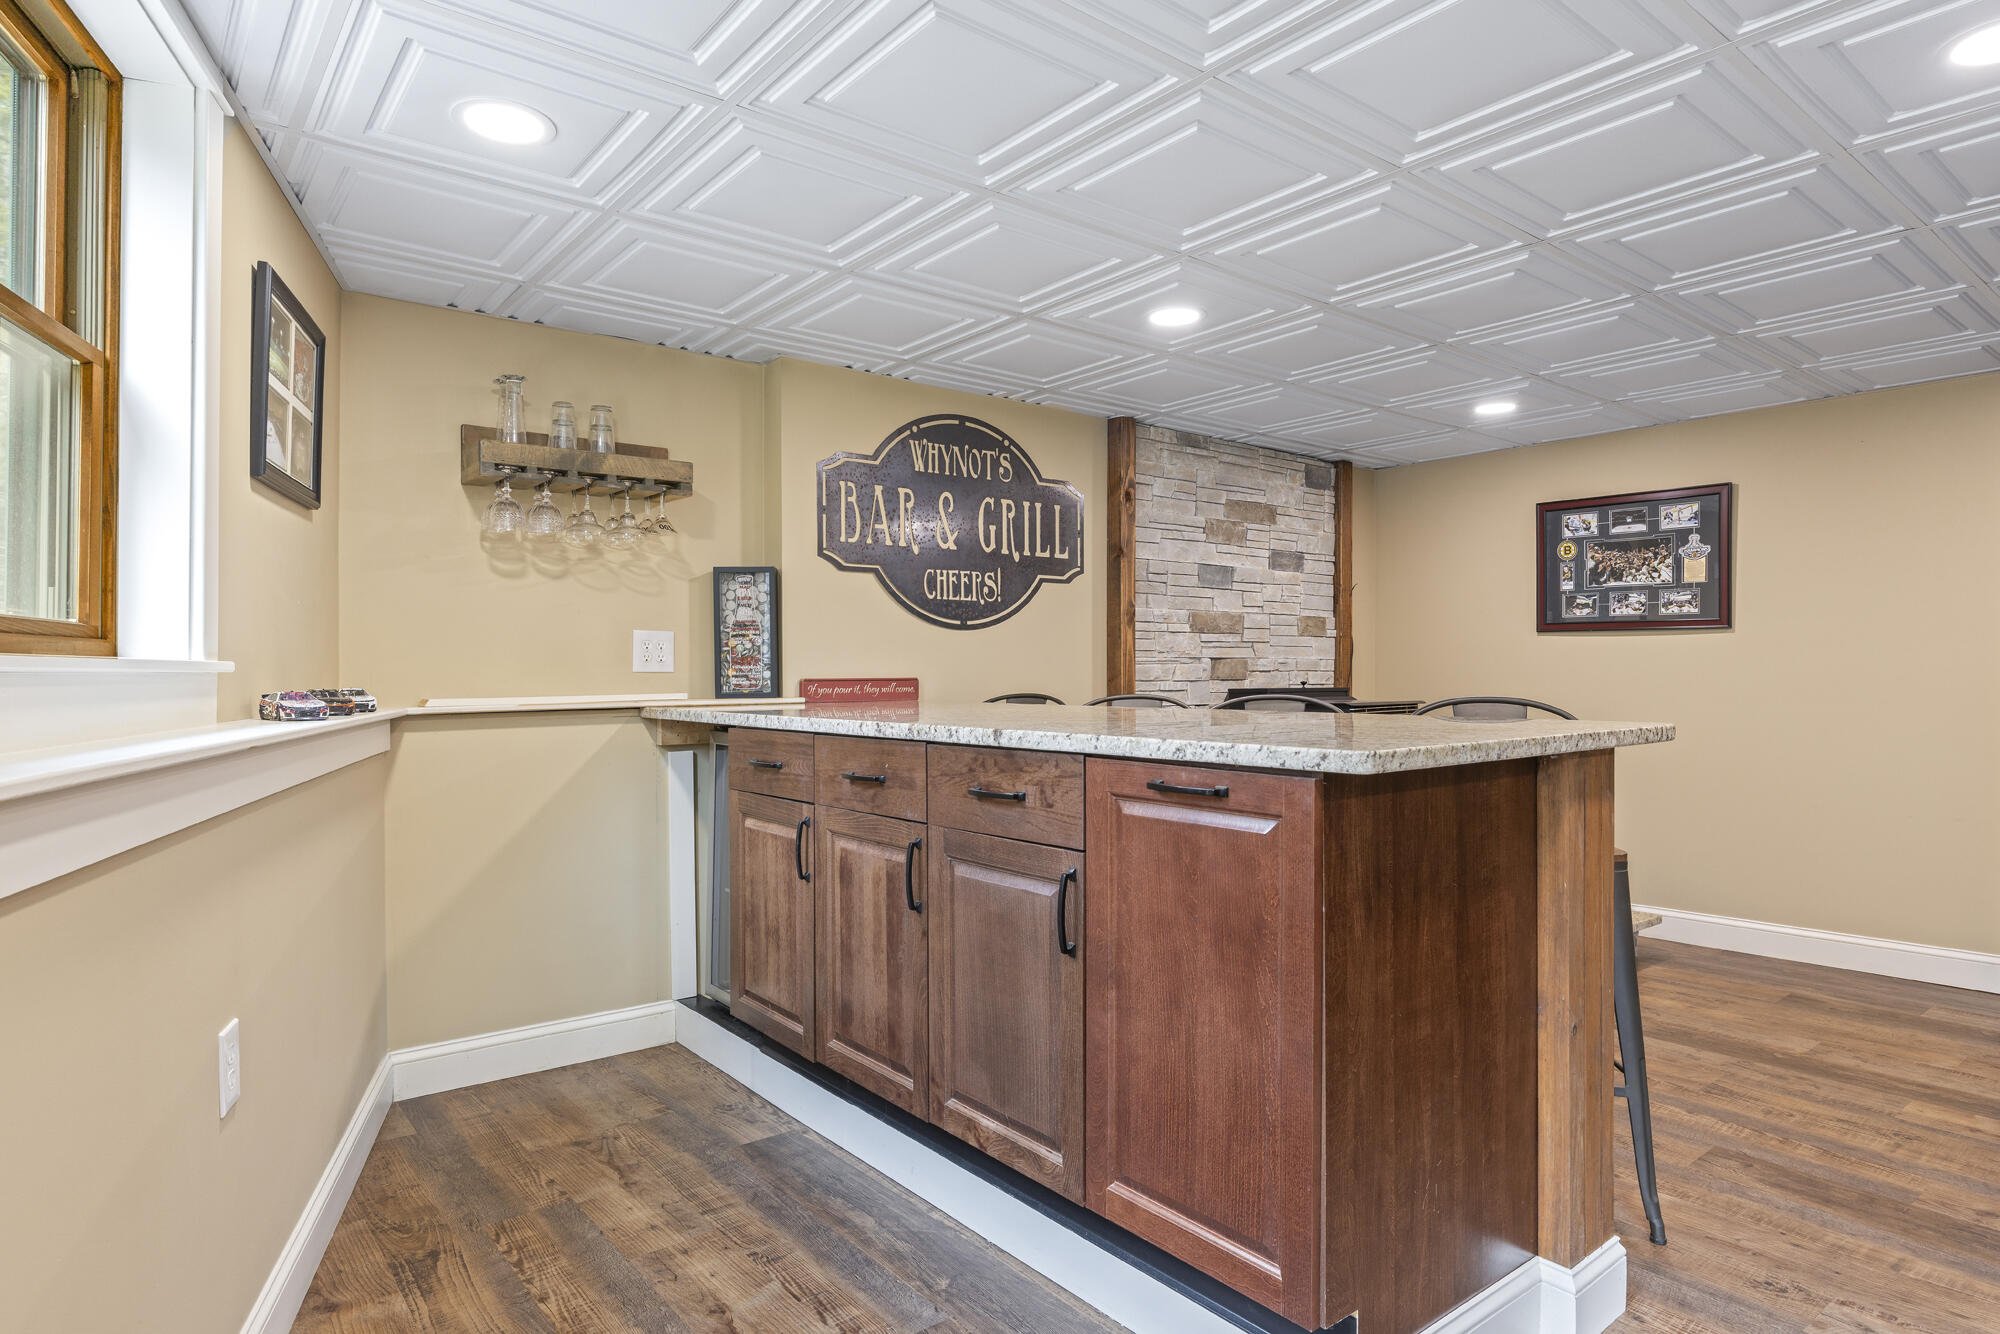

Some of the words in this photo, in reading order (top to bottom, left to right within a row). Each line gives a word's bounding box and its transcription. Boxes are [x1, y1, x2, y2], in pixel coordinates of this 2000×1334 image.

[909, 439, 1012, 482] WHYNOT'S
[839, 481, 918, 555] BAR
[936, 492, 960, 550] &
[979, 497, 1068, 562] GRILL
[924, 568, 1001, 605] CHEERS!
[808, 684, 818, 696] If
[817, 687, 832, 698] you
[833, 687, 852, 698] pour
[864, 683, 879, 697] they
[882, 683, 896, 693] will
